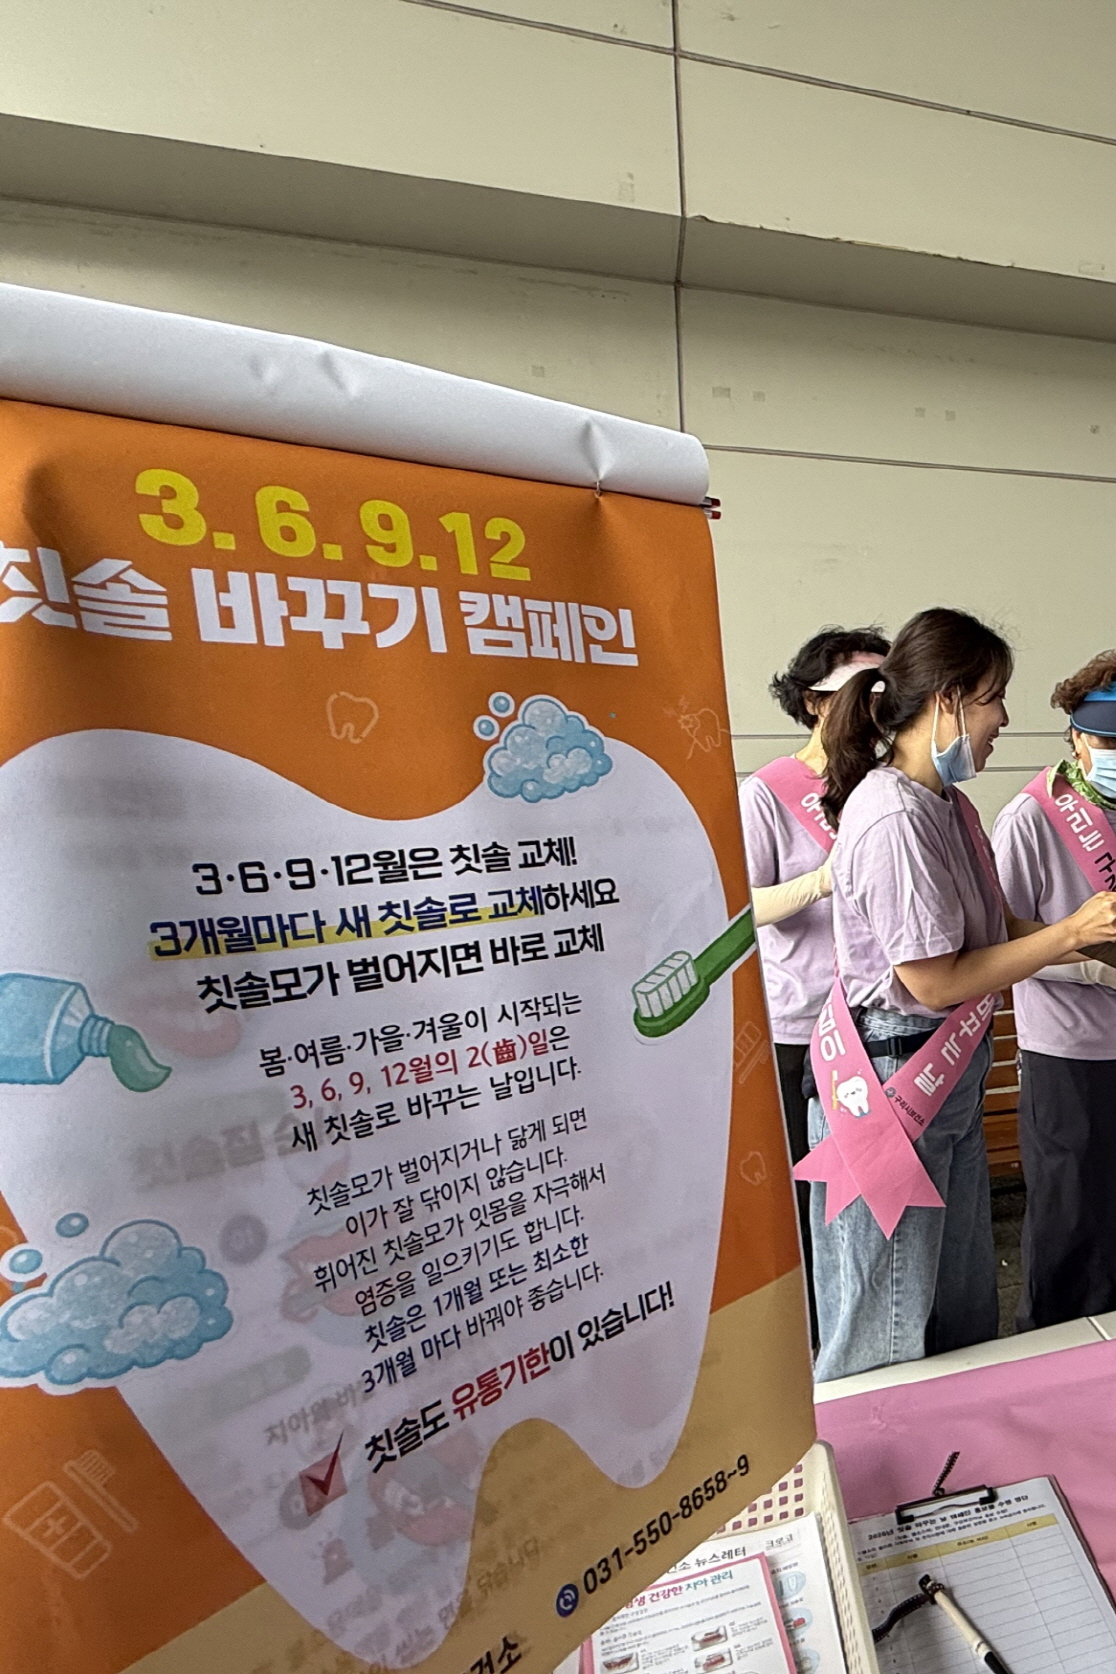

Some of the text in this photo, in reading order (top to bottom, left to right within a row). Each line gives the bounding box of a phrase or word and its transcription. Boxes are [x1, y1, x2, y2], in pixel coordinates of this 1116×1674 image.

[0, 541, 638, 667] 칫솔 바꾸기 캠페인
[451, 842, 512, 876] 칫솔
[517, 836, 577, 869] 교체!
[1054, 793, 1104, 852] 우리는
[150, 878, 620, 957] 3개월마다 새 칫솔로 교체하세요
[197, 924, 605, 1014] 칫솔모가 벌어지면 바로 교체
[497, 992, 583, 1027] 시작되는
[290, 1083, 313, 1109] 3,
[320, 1079, 342, 1104] 6,
[349, 1072, 371, 1097] 9,
[380, 1052, 459, 1087] 12월의
[913, 994, 995, 1097] 바꾸는 날
[290, 1124, 318, 1153] 새
[325, 1104, 402, 1145] 칫솔로
[407, 1083, 481, 1118] 바꾸는
[489, 1056, 582, 1101] 날입니다.
[894, 1095, 925, 1127] 구리시보건소
[306, 1108, 588, 1216] 칫솔모가 벌어지거나 닳게 되면
[345, 1149, 568, 1239] 이가 잘 닦이지 않습니다.
[314, 1162, 606, 1291] 휘어진 칫솔모가 잇몸을 자극해서
[354, 1206, 585, 1317] 염증을 일으키기도 합니다.
[362, 1261, 604, 1394] 3개월 마다 바꿔야 좋습니다.
[364, 1234, 590, 1353] 칫솔은 1개월 또는 최소한
[364, 1397, 450, 1473] 칫솔도
[451, 1330, 576, 1417] 유통기한이
[578, 1283, 676, 1354] 있습니다!
[583, 1454, 750, 1594] 031-550-8658~9
[694, 1545, 748, 1569] 뉴스레터
[648, 1585, 684, 1605] 건강한
[685, 1577, 709, 1592] 치아
[710, 1569, 734, 1586] 관리
